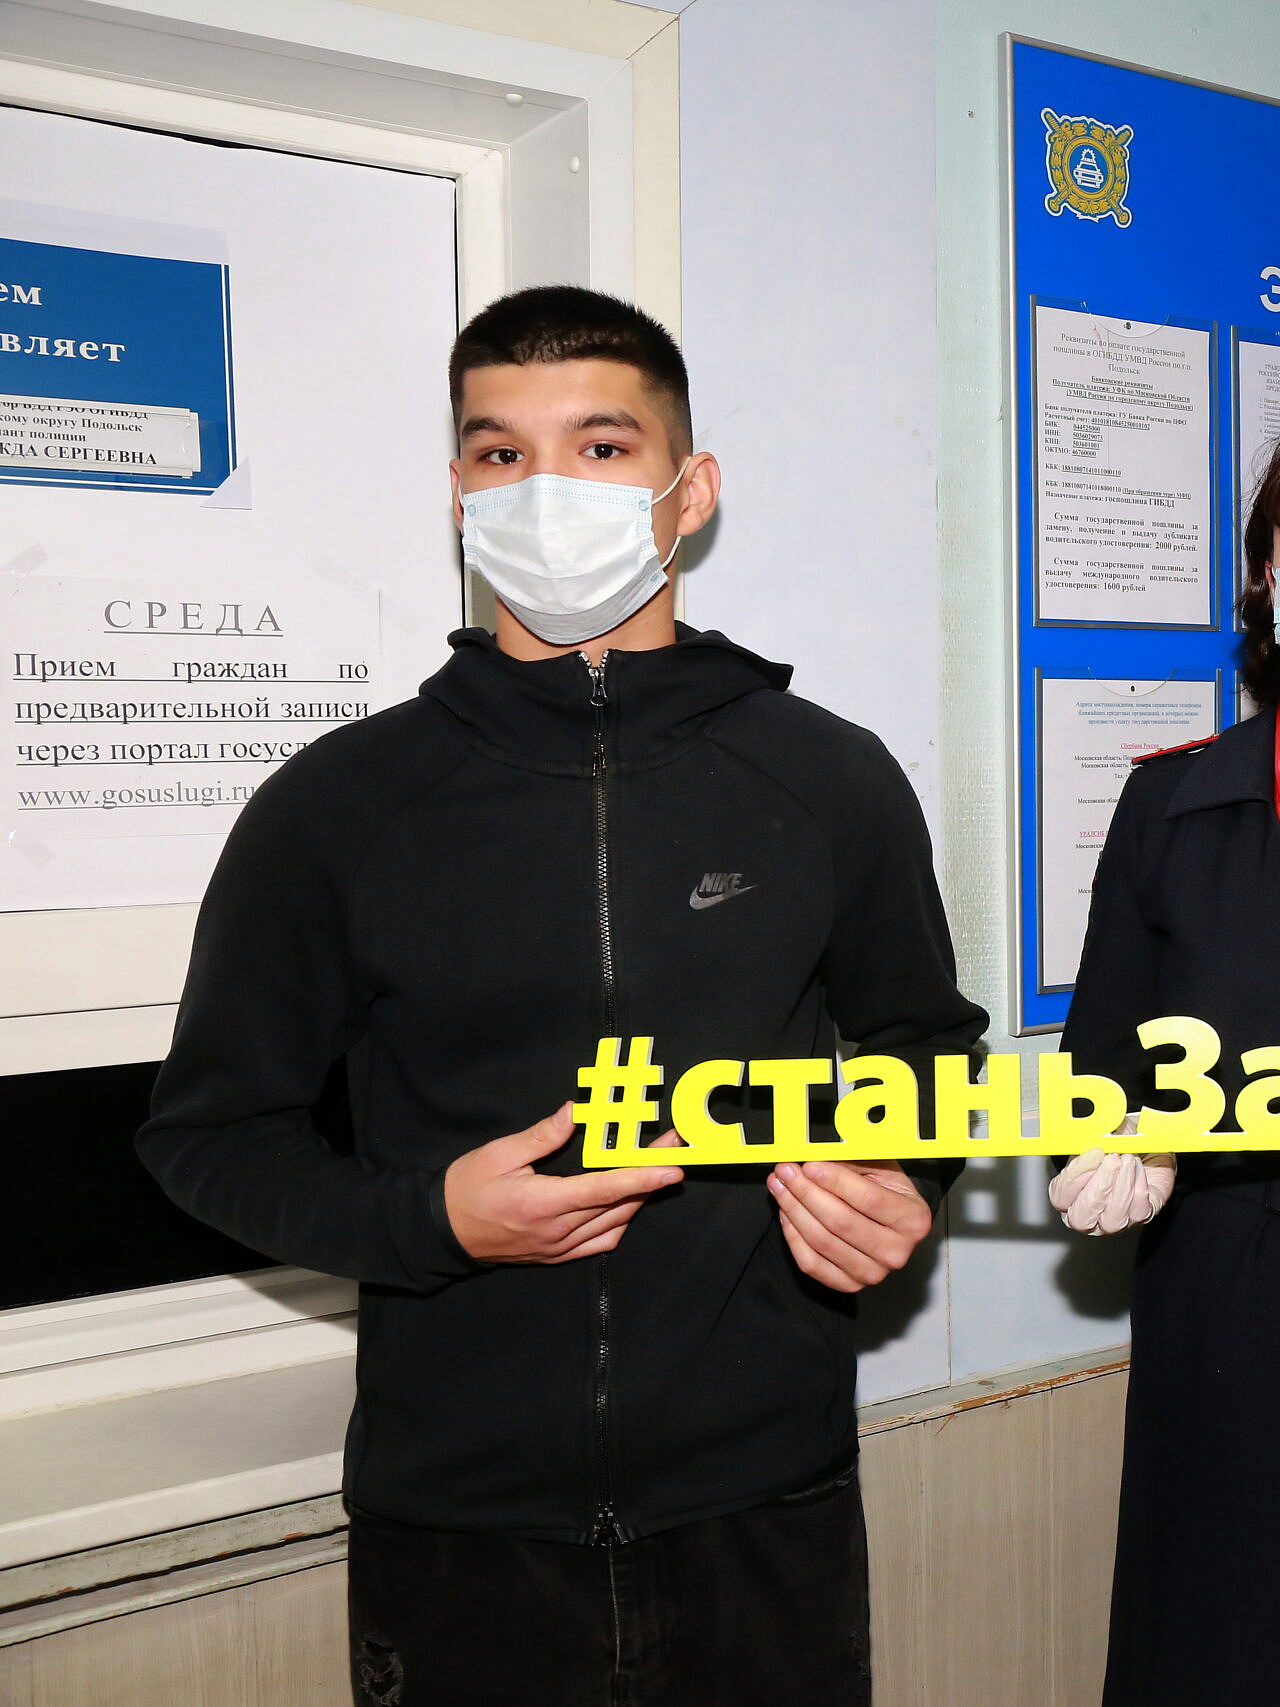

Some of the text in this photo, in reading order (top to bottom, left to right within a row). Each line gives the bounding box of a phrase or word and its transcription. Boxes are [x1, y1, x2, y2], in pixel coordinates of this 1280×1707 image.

[0, 332, 125, 362] вляет
[1061, 333, 1097, 346] Реквизиты
[1109, 341, 1130, 351] оплате
[1132, 344, 1185, 358] государственной
[1053, 345, 1085, 356] пошлины
[1093, 350, 1123, 361] ОГИБДД
[1125, 355, 1147, 365] УМВД
[1149, 359, 1171, 367] России
[1109, 364, 1141, 375] Подольск
[33, 416, 77, 428] округу
[82, 419, 142, 432] Подольск
[30, 432, 86, 442] полиции
[44, 445, 156, 464] СЕРГЕЕВНА
[1149, 498, 1175, 508] ГИБДД
[1054, 512, 1078, 522] Сумма
[1086, 515, 1144, 526] государственной
[1152, 521, 1184, 529] пошлины
[1046, 525, 1073, 533] замену,
[1079, 527, 1115, 536] получение
[1132, 531, 1157, 539] выдачу
[1164, 532, 1198, 541] дубликата
[1046, 536, 1198, 552] водительского удостоверения: 2000 рублей.
[1054, 557, 1078, 567] Сумма
[1086, 560, 1144, 570] государственной
[1083, 571, 1139, 580] международного
[1150, 575, 1198, 583] водительского
[1045, 581, 1146, 592] удостоверения: 1600 рублей
[104, 600, 283, 636] СРЕДА
[13, 653, 369, 683] Прием граждан по
[15, 697, 369, 724] предварительной записи
[17, 744, 100, 767] через
[110, 742, 209, 765] портал
[18, 781, 255, 809] www.gosuslugi.ru
[699, 873, 744, 892] NIKE
